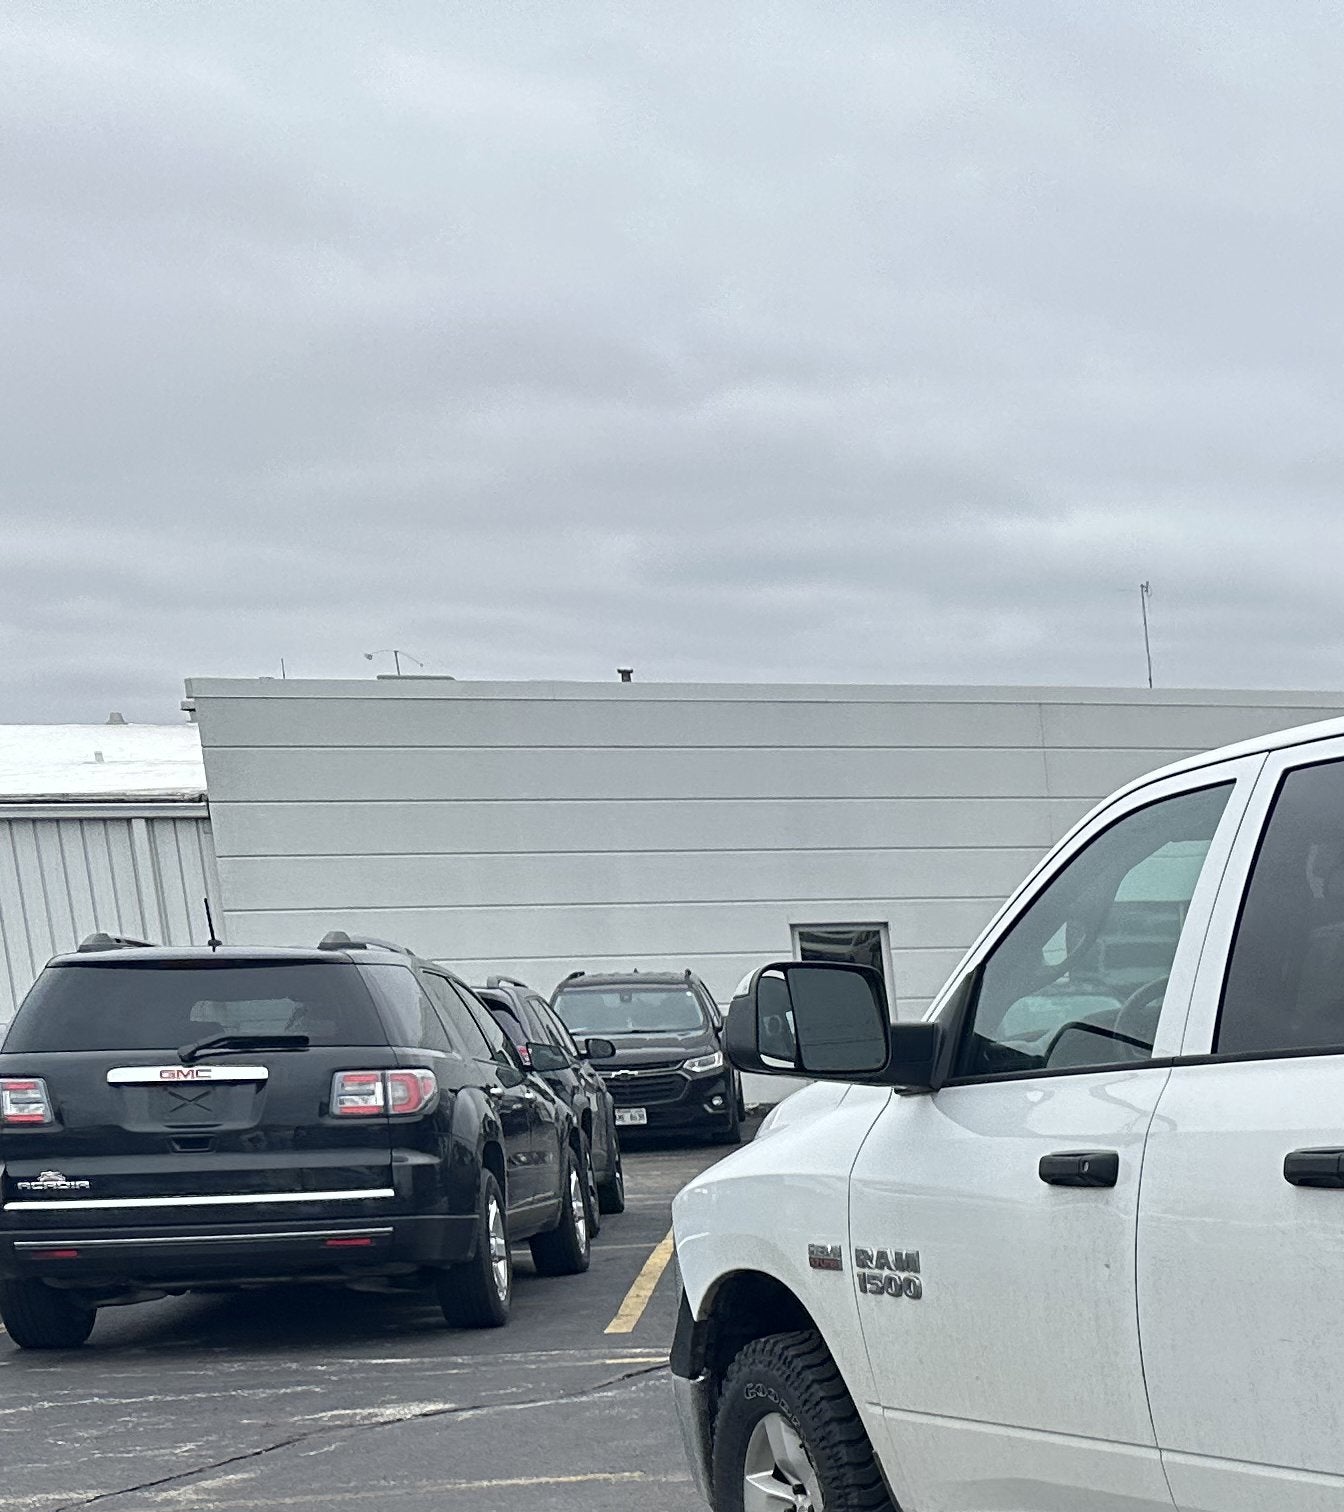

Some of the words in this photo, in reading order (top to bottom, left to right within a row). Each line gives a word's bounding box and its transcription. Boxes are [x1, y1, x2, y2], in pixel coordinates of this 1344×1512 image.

[160, 1069, 212, 1079] GMC
[17, 1181, 90, 1190] ACADIA
[855, 1247, 920, 1273] RAM
[857, 1271, 923, 1300] 1500
